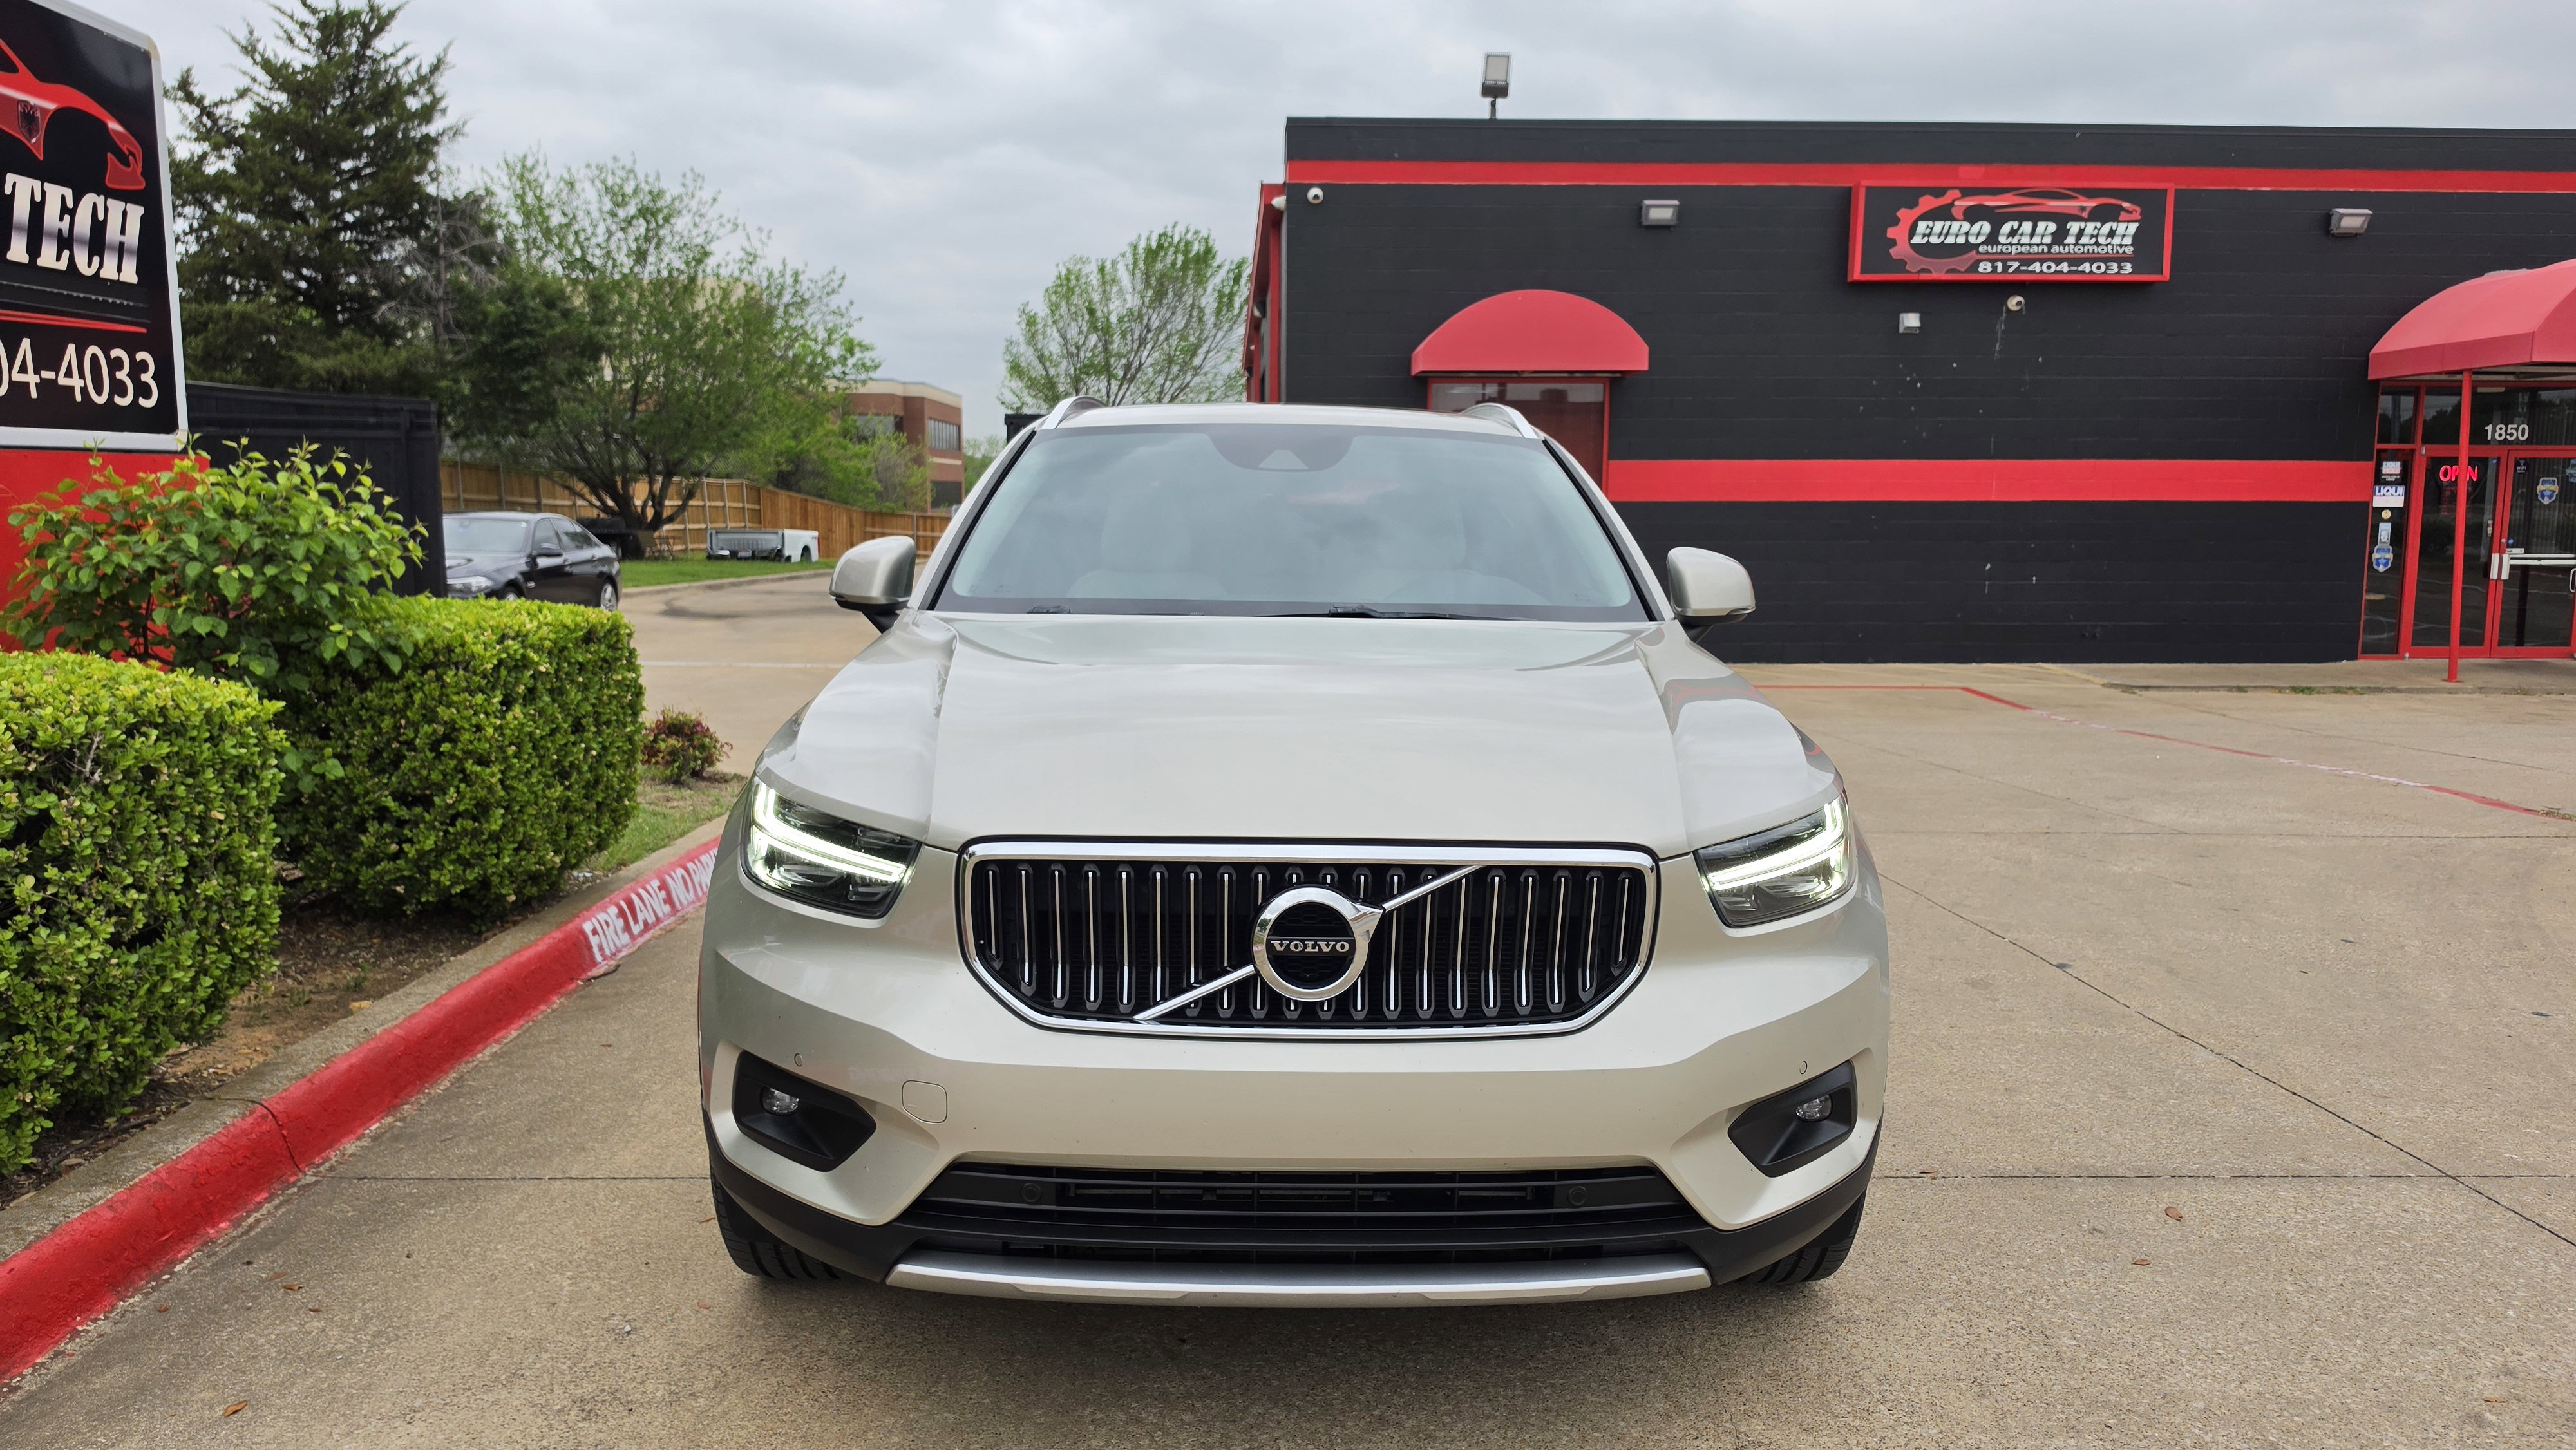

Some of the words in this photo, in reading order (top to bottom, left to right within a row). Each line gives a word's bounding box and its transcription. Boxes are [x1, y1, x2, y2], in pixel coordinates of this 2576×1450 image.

[5, 172, 145, 285] TECH
[1909, 220, 1991, 244] EURO
[1998, 221, 2057, 244] CAR
[2063, 221, 2140, 245] TECH
[1978, 244, 2048, 256] european
[2050, 243, 2134, 254] automotive
[1978, 261, 2133, 274] 817-404-4033
[2485, 423, 2529, 441] 1850
[2439, 465, 2478, 482] OPN
[2375, 485, 2403, 497] LIQUI
[582, 905, 630, 964] FIRE
[620, 879, 670, 936] LANE
[664, 867, 696, 910] NO
[1270, 940, 1350, 953] VOLVO
